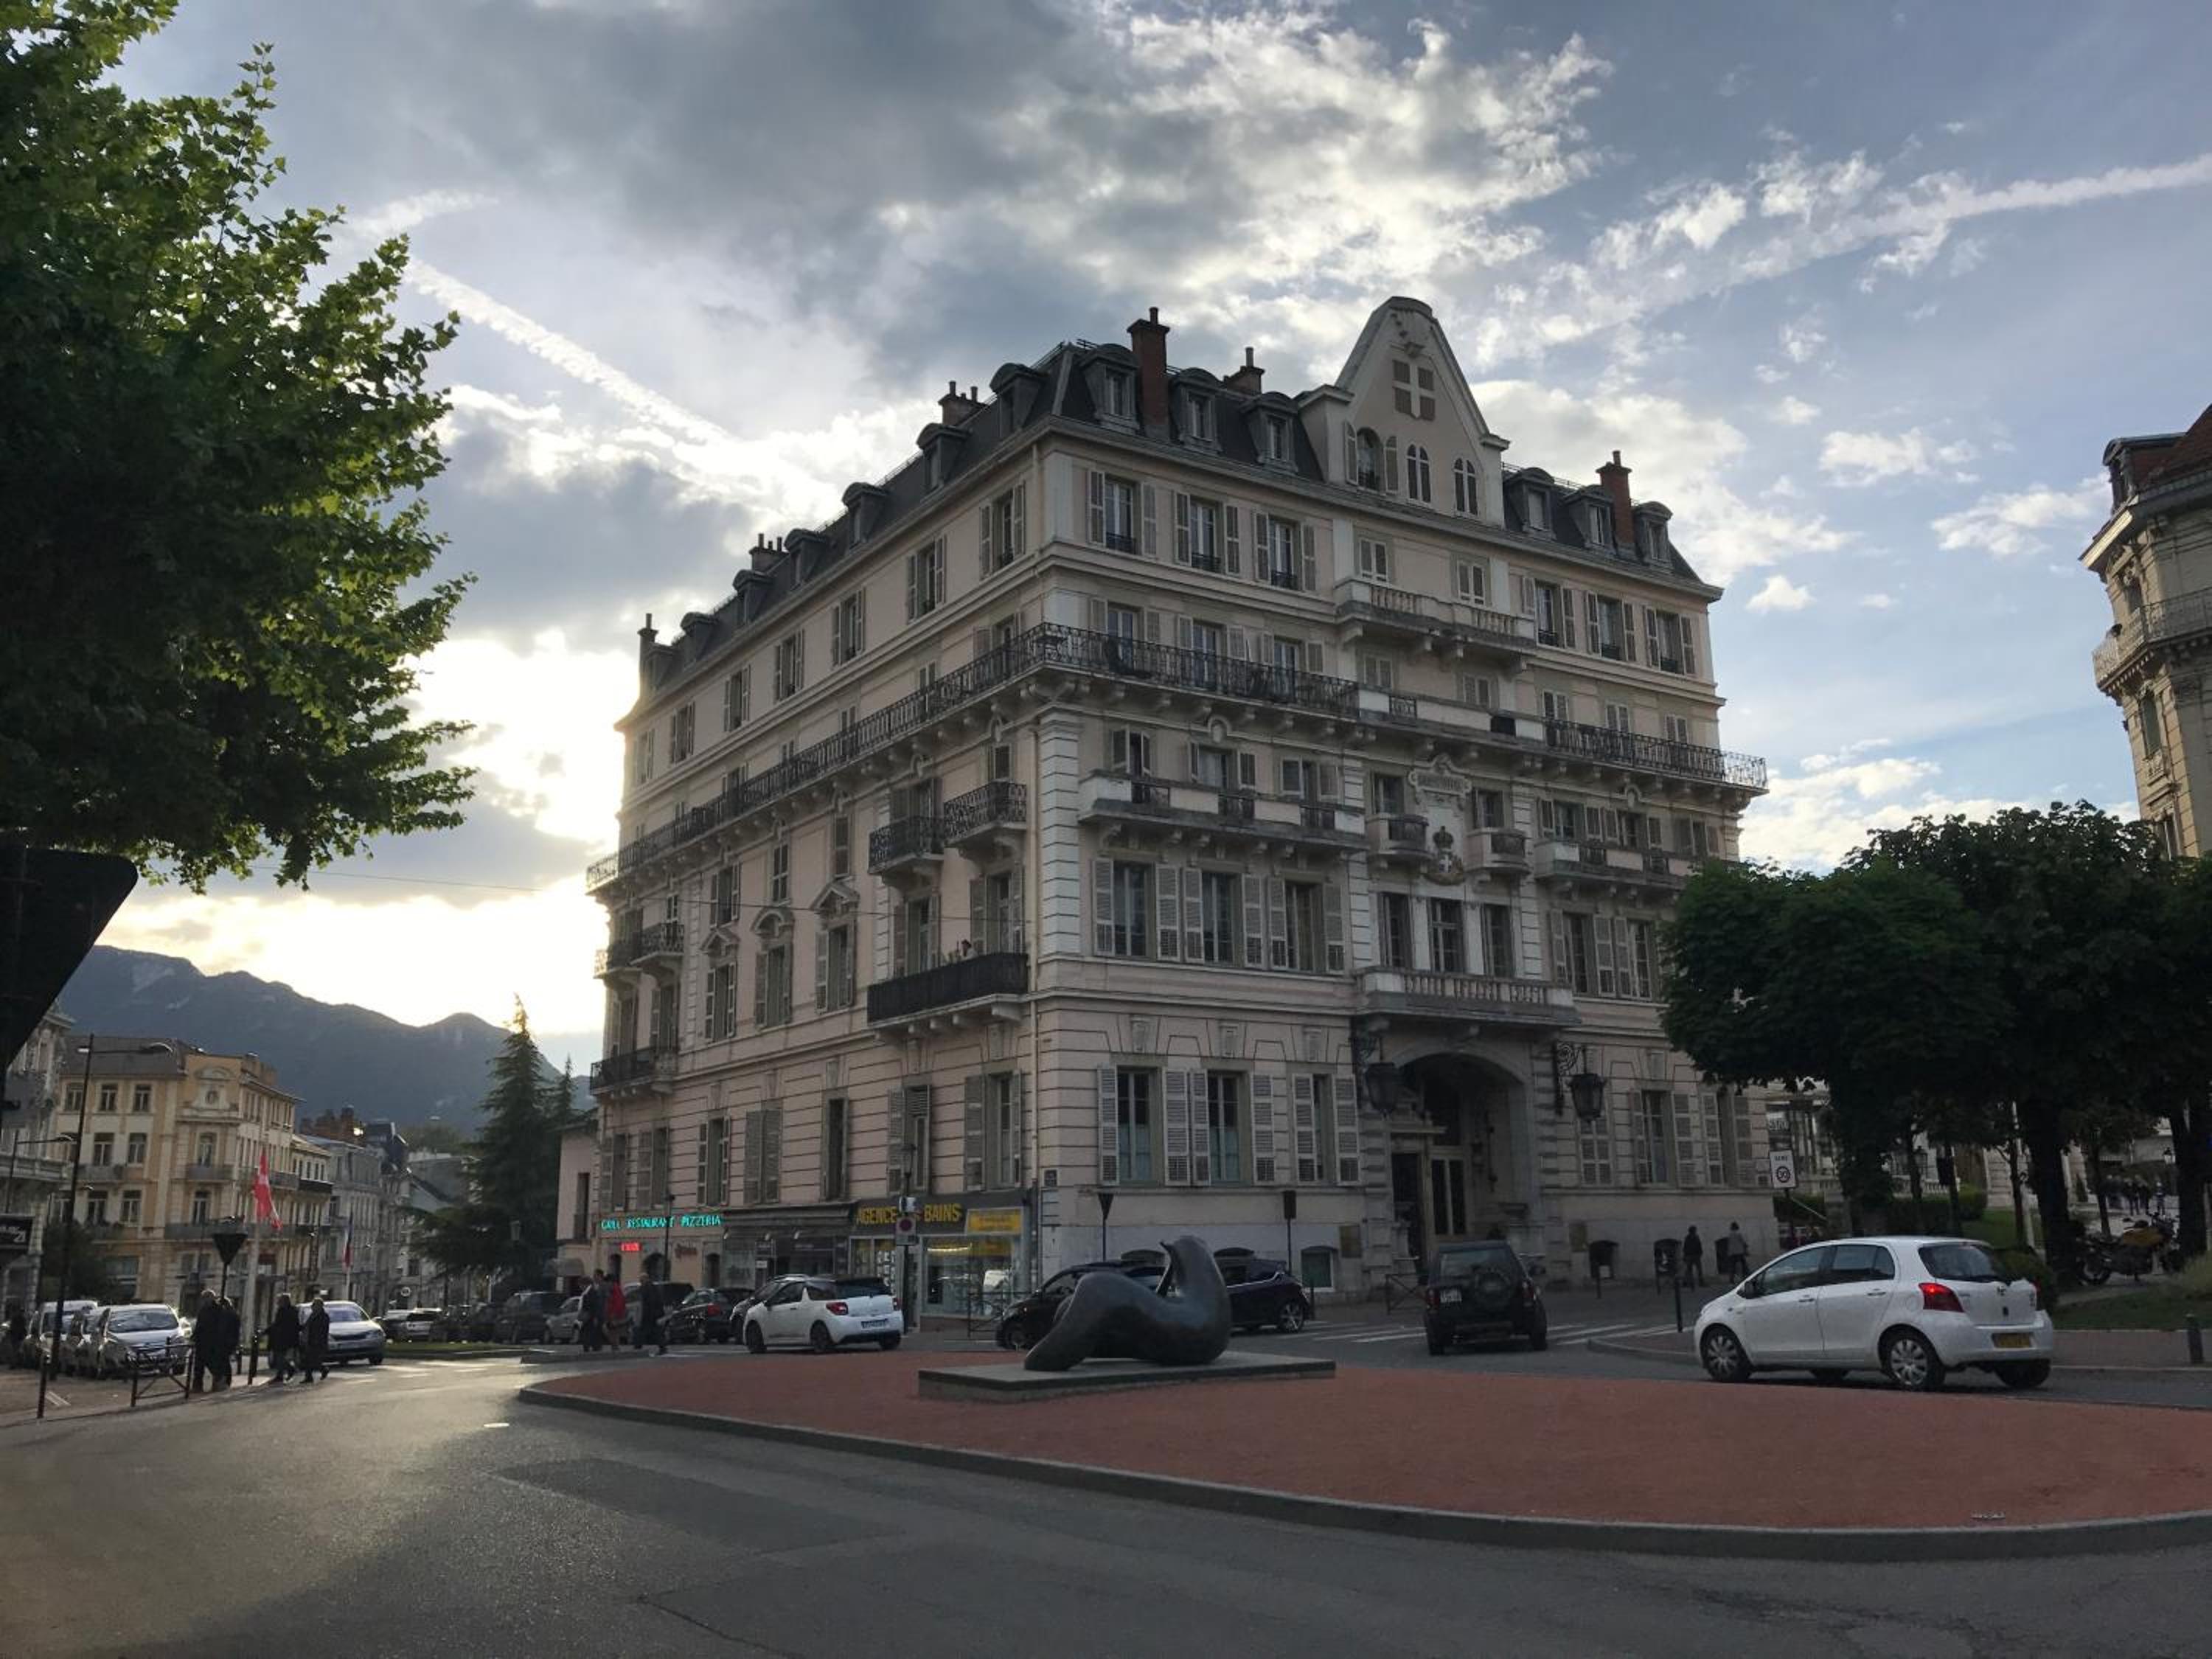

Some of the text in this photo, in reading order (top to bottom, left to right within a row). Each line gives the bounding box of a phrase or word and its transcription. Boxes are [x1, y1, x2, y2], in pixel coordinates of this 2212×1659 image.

[681, 1214, 721, 1227] PIZZERIA
[857, 1206, 897, 1225] AGENCE
[924, 1203, 961, 1222] BAINS
